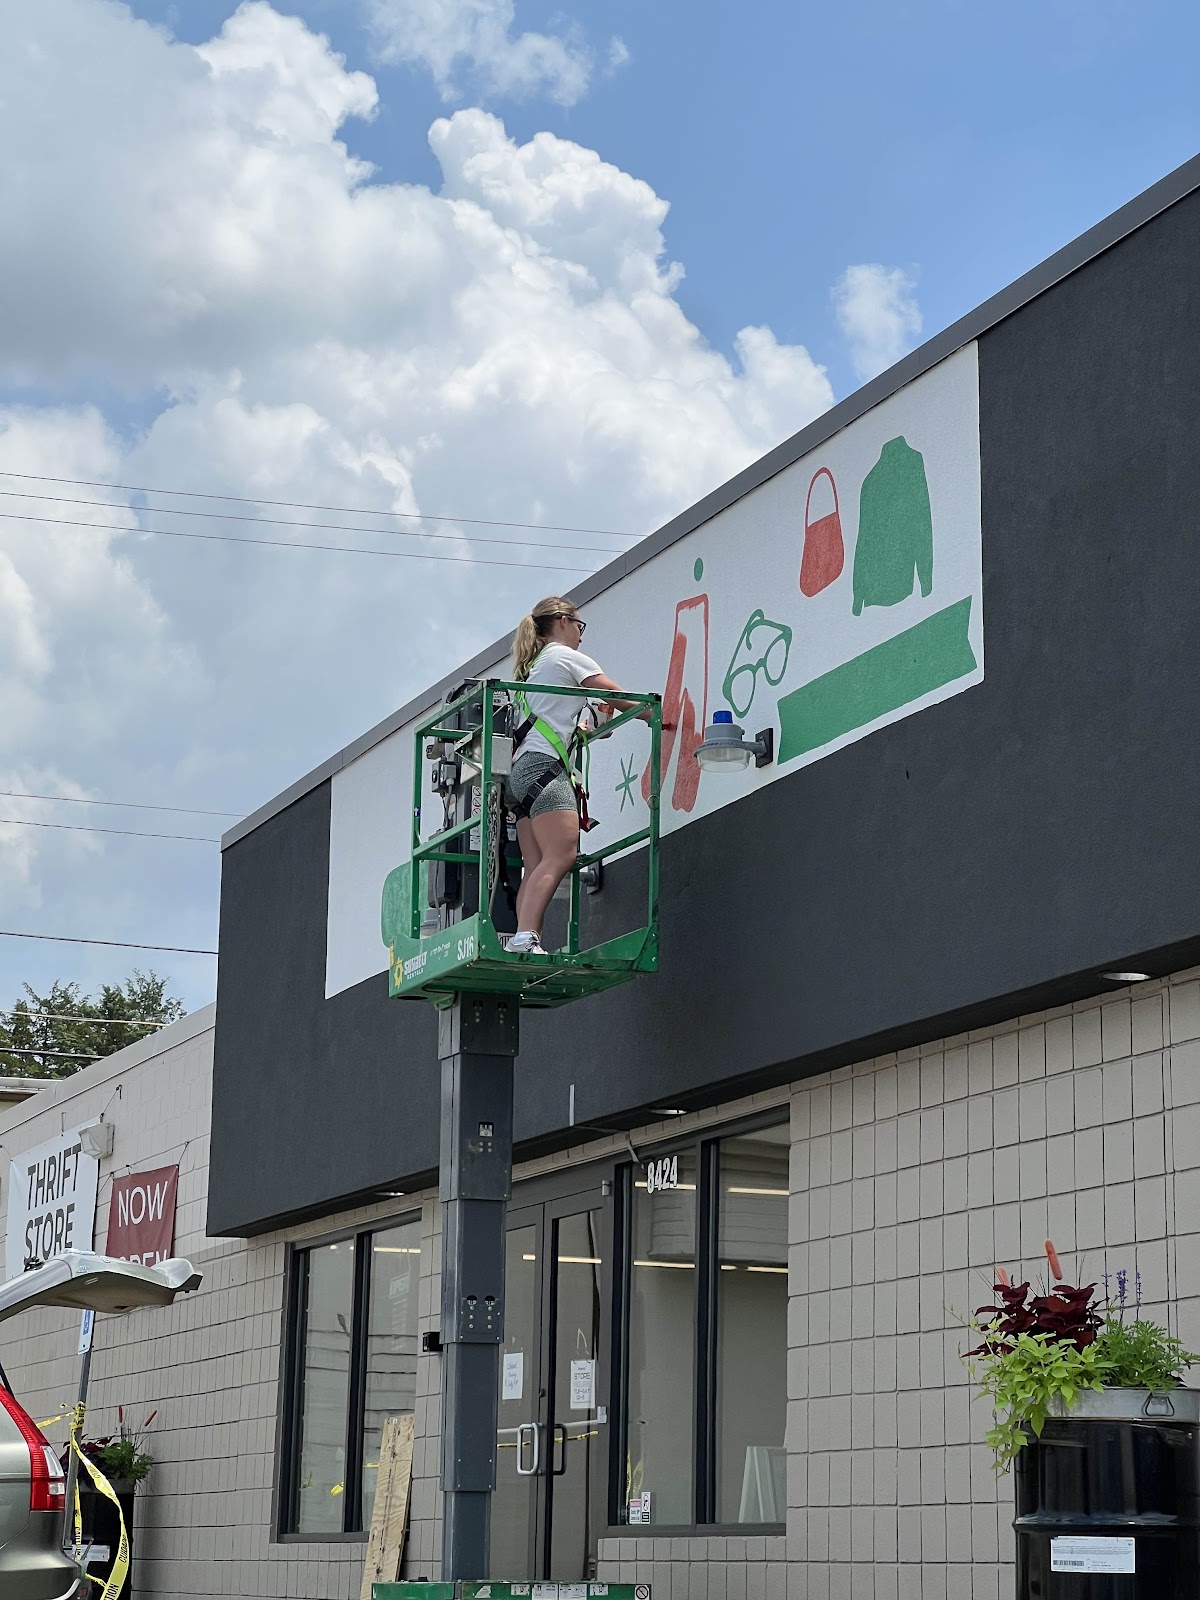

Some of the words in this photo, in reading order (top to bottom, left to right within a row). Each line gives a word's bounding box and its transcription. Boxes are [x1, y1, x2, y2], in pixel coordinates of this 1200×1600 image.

[457, 936, 474, 961] SJ16
[407, 968, 424, 980] RENTALS
[28, 1143, 81, 1210] THRIFT
[647, 1155, 678, 1194] 8424
[118, 1181, 168, 1228] NOW
[24, 1203, 75, 1263] STORE
[574, 1372, 591, 1380] STORE
[105, 1583, 119, 1600] TION
